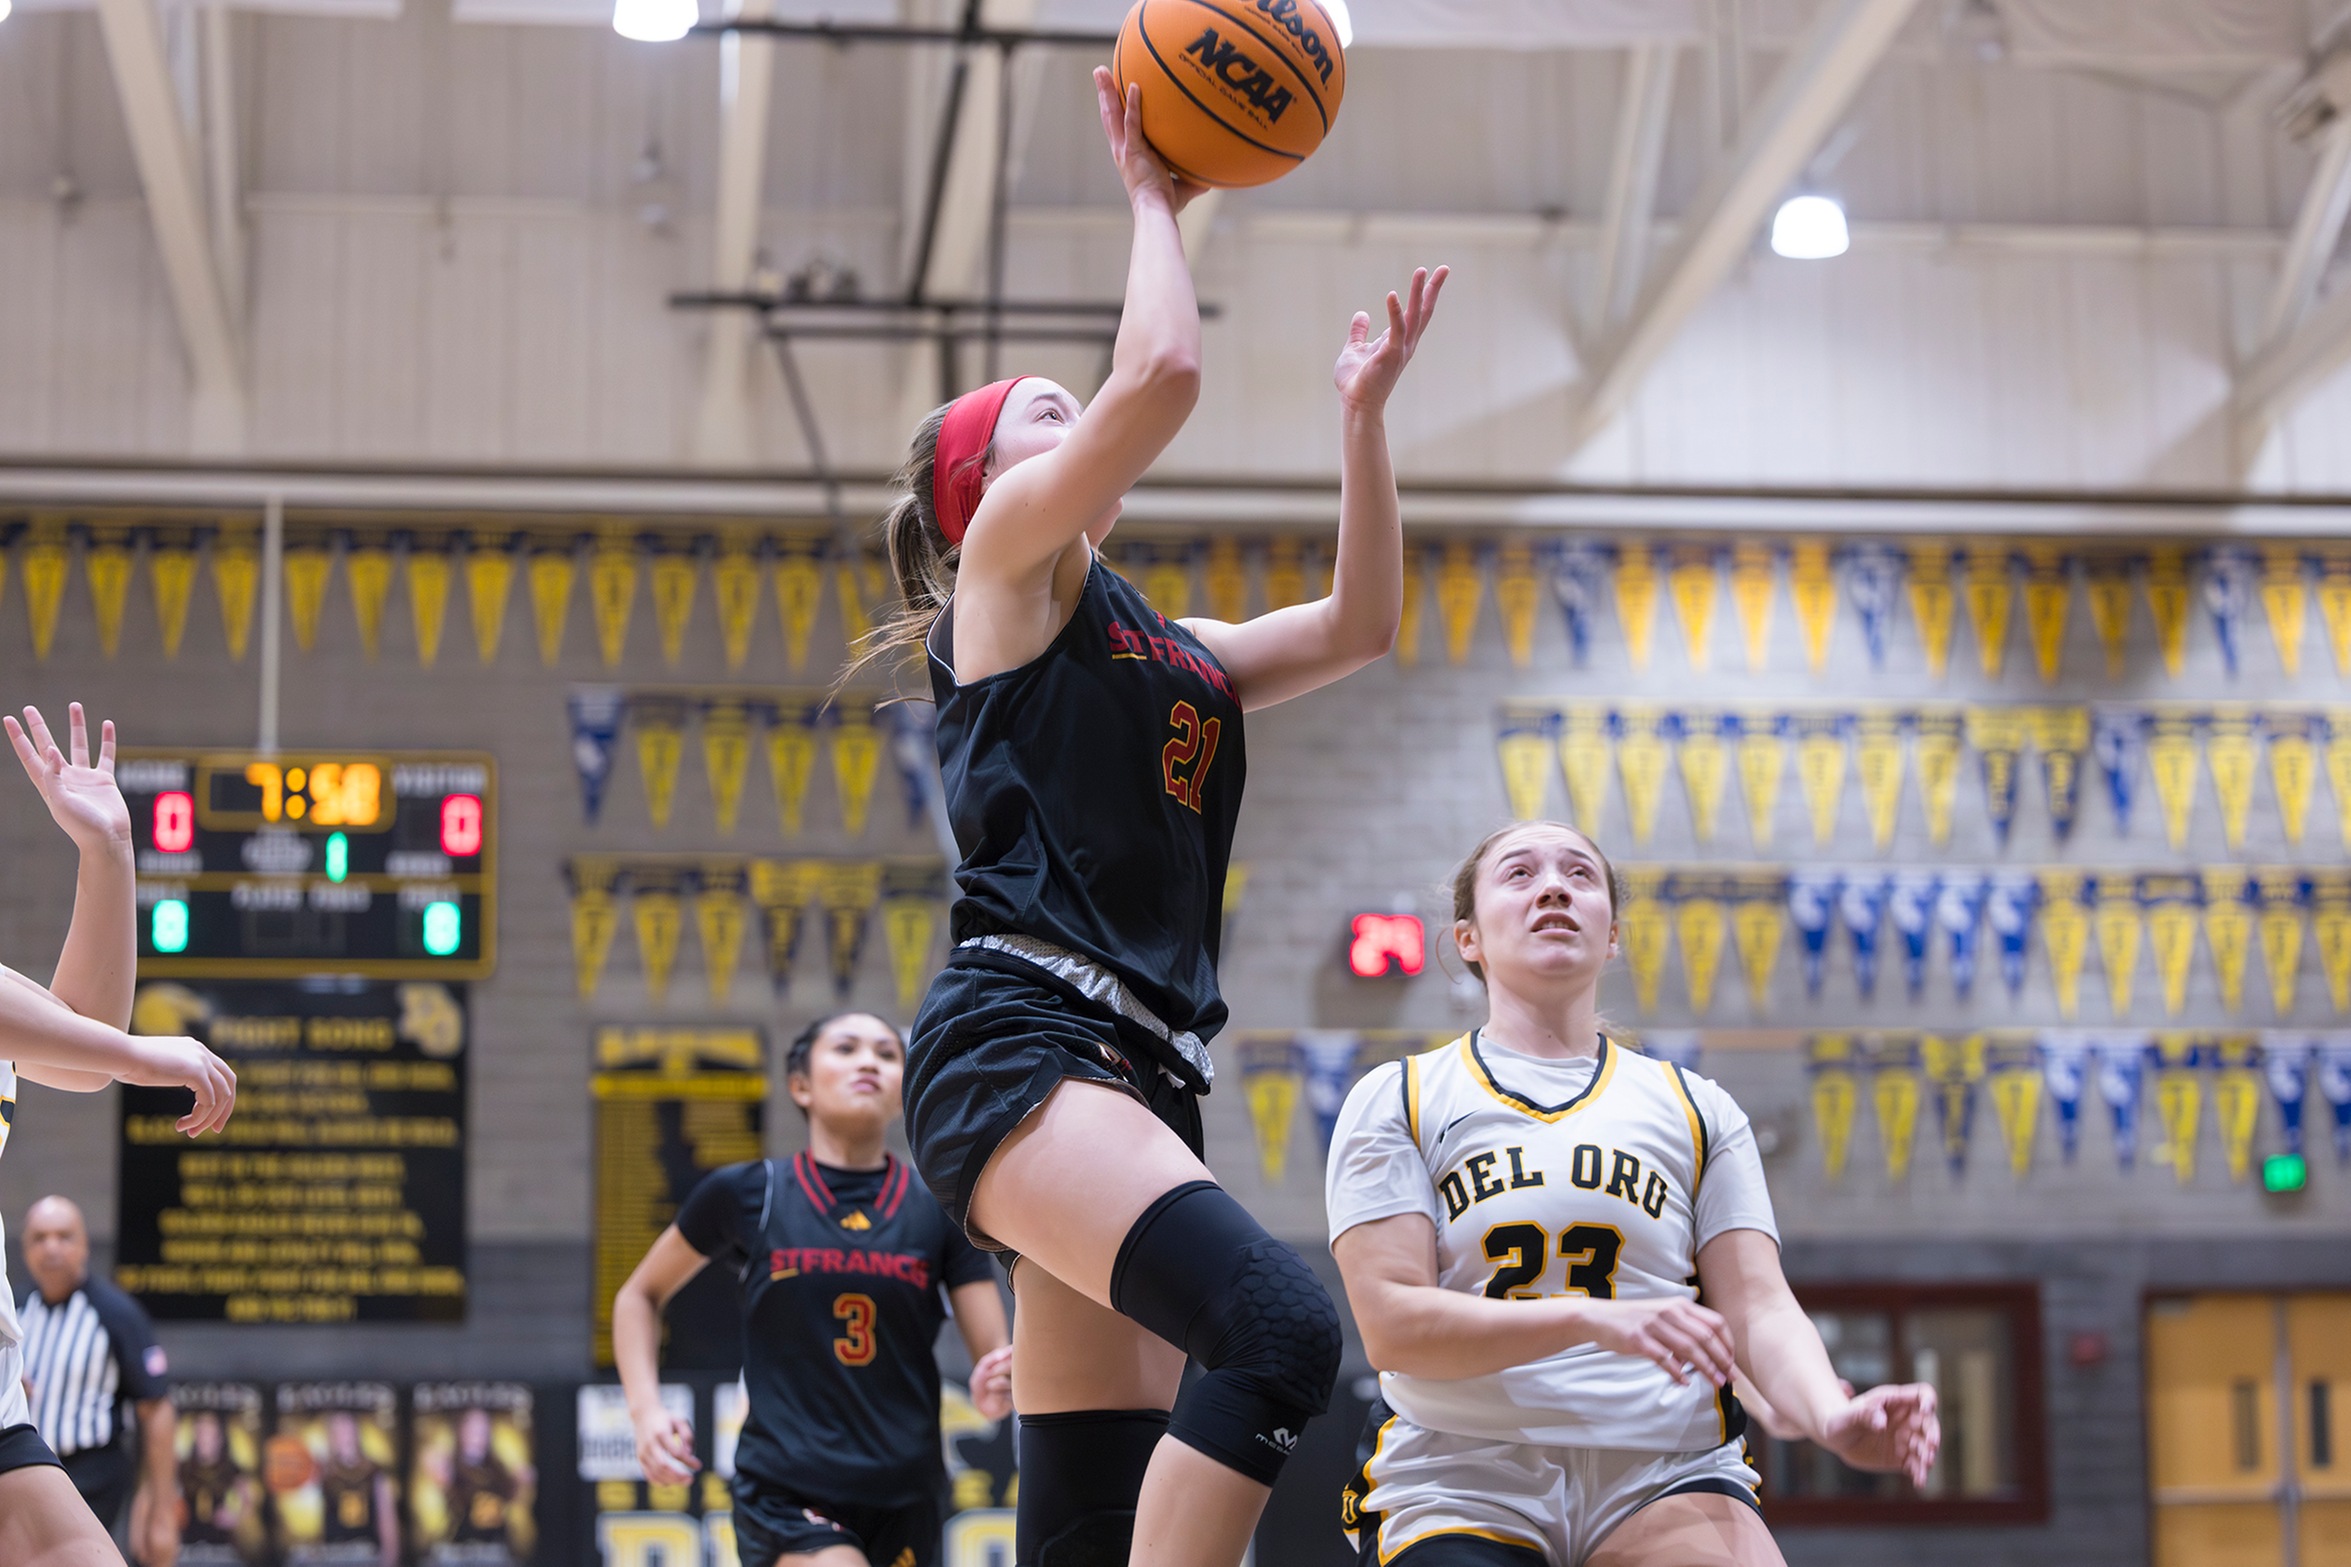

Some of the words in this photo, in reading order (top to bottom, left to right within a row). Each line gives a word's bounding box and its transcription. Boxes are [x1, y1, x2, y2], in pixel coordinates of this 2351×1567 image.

[1185, 27, 1294, 124] NCAA
[1107, 620, 1146, 654] ST
[1162, 699, 1221, 815] 21
[153, 791, 194, 853] 0
[440, 794, 482, 856] 0
[1438, 1145, 1545, 1223] DEL
[1569, 1143, 1669, 1220] ORO
[769, 1248, 799, 1274] ST
[1480, 1220, 1626, 1300] 23
[833, 1292, 877, 1367] 3
